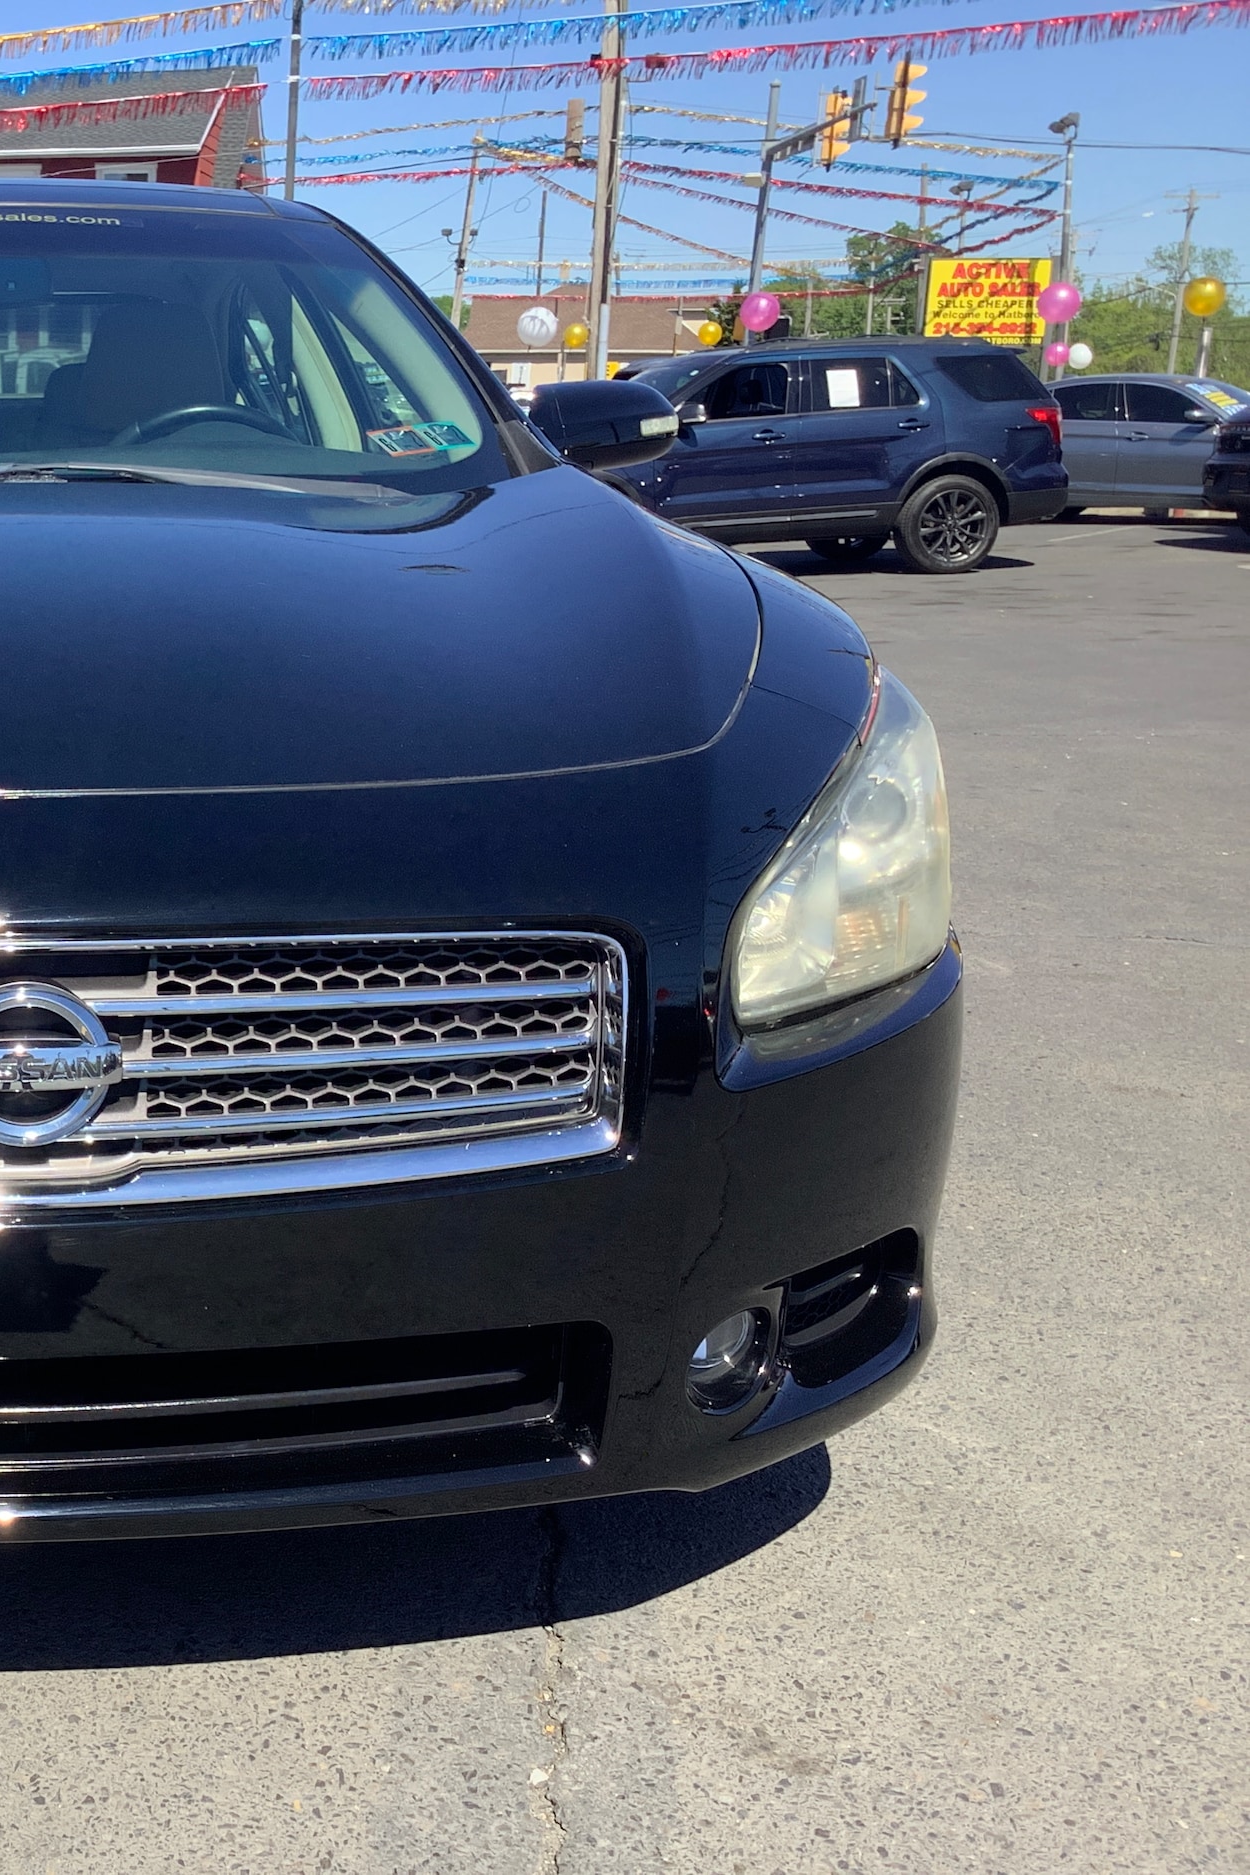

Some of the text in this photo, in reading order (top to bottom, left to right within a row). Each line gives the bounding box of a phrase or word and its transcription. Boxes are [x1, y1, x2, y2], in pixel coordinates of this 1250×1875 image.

[952, 262, 1031, 280] ACTIVE
[937, 282, 1041, 297] AUTO SALES
[937, 300, 974, 309] SELLS
[933, 310, 981, 319] Welcome
[984, 310, 995, 319] to
